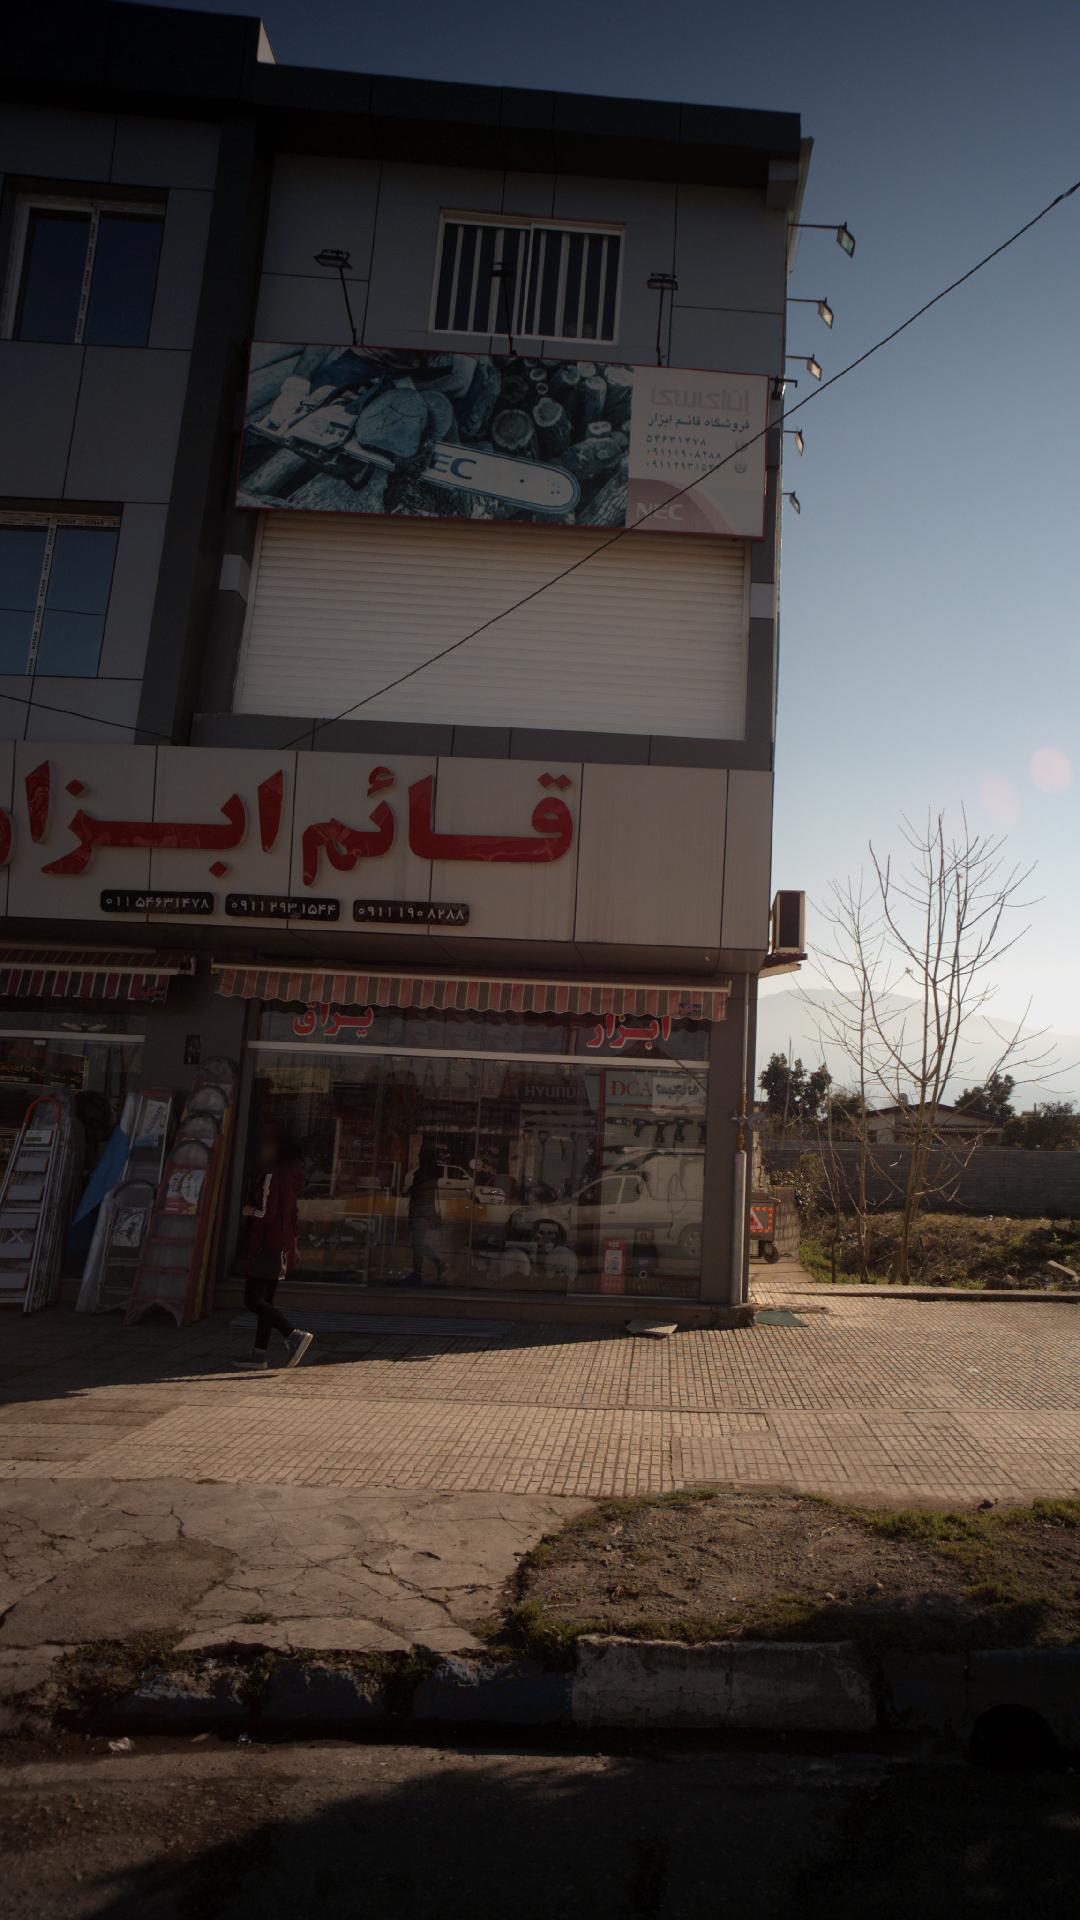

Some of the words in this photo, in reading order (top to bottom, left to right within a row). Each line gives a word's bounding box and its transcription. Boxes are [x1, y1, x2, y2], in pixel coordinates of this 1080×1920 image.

[648, 412, 672, 428] ابزار
[705, 418, 750, 433] فروشگاه
[636, 501, 684, 520] NEC
[0, 760, 285, 879] ابزا
[302, 766, 574, 887] قائم
[292, 1002, 374, 1038] یراق
[586, 1014, 671, 1050] ابزار
[611, 1080, 652, 1097] DCA
